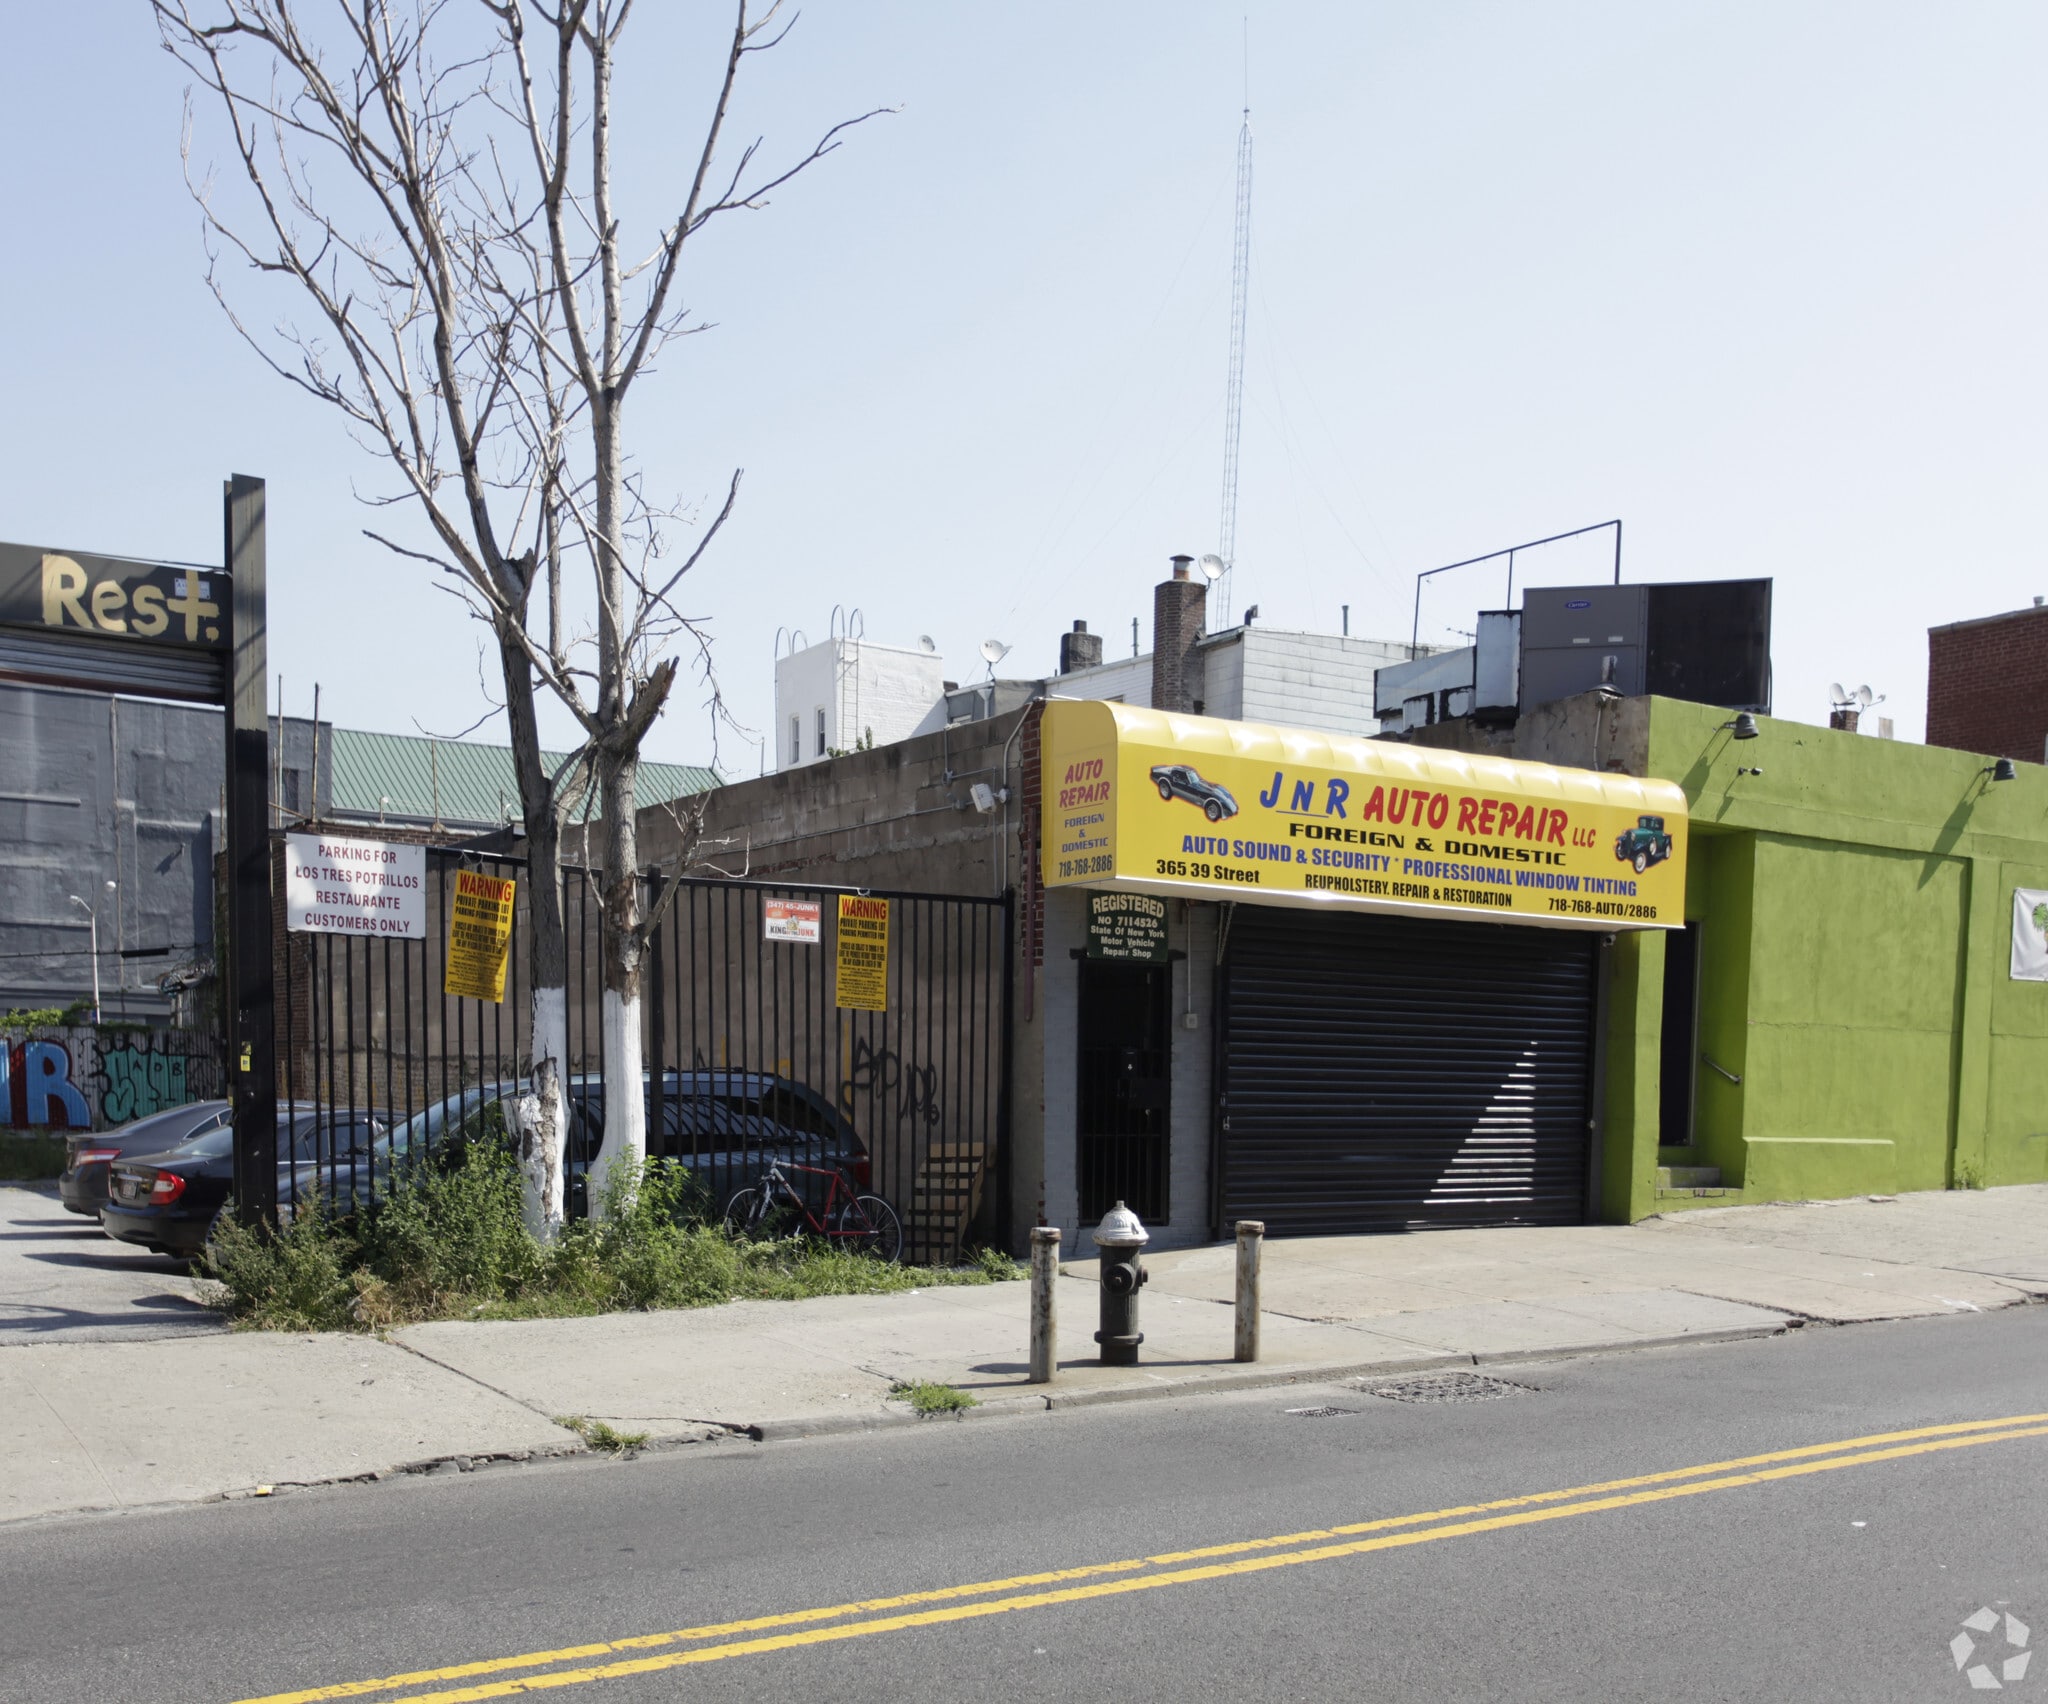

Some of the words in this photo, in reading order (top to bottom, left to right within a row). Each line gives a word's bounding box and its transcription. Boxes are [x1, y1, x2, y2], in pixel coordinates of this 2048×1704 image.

[42, 554, 219, 642] Rest.
[1065, 759, 1103, 784] AUTO
[1059, 781, 1110, 808] REPAIR
[1064, 813, 1105, 828] FOREIGN
[1363, 785, 1449, 830] AUTO
[1457, 796, 1568, 847] REPAIR
[1572, 827, 1596, 848] LLC
[1078, 828, 1086, 838] &
[318, 844, 371, 861] PARKING
[374, 850, 397, 864] FOR
[1062, 837, 1108, 853] DOMESTIC
[1289, 822, 1405, 849] FOREIGN
[1415, 836, 1434, 853] &
[1445, 840, 1567, 866] DOMESTIC
[1059, 854, 1112, 878] 718-768-2886
[1156, 859, 1186, 876] 365
[1191, 862, 1210, 878] 39
[1214, 865, 1260, 883] Street
[1182, 835, 1228, 856] AUTO
[1233, 839, 1291, 863] SOUND
[1296, 849, 1307, 864] &
[1312, 847, 1391, 873] SECURITY
[1403, 858, 1512, 886] PROFESSIONAL
[1516, 870, 1580, 891] WINDOW
[1583, 877, 1637, 897] TINTING
[295, 866, 319, 880] LOS
[322, 868, 352, 883] TRES
[355, 871, 418, 888] POTRILLOS
[460, 872, 512, 903] WARNING
[316, 890, 400, 910] RESTAURANTE
[456, 894, 477, 908] PRIVATE
[478, 898, 500, 913] PARKING
[501, 902, 509, 914] LOT
[1393, 882, 1430, 899] REPAIR
[1433, 888, 1441, 901] &
[1443, 887, 1512, 907] RESTORATION
[455, 905, 475, 918] PARKING
[842, 898, 886, 920] WARNING
[1092, 894, 1164, 918] REGISTERED
[1549, 897, 1657, 919] 718-768-AUTO/2886
[305, 912, 377, 931] CUSTOMERS
[380, 919, 410, 933] ONLY
[770, 925, 787, 935] KING
[797, 927, 815, 937] JUNK
[840, 917, 857, 928] PRIVATE
[858, 920, 877, 930] PARKING
[840, 928, 857, 937] PARKING
[1090, 925, 1112, 934] State
[1114, 927, 1124, 935] Of
[1127, 928, 1144, 937] New
[1148, 929, 1165, 938] York
[1097, 916, 1112, 925] NO
[1117, 916, 1158, 928] 7114526
[1100, 936, 1123, 945] Motor
[1127, 937, 1155, 947] Vehicle
[1103, 947, 1129, 957] Repair
[1132, 948, 1152, 959] Shop
